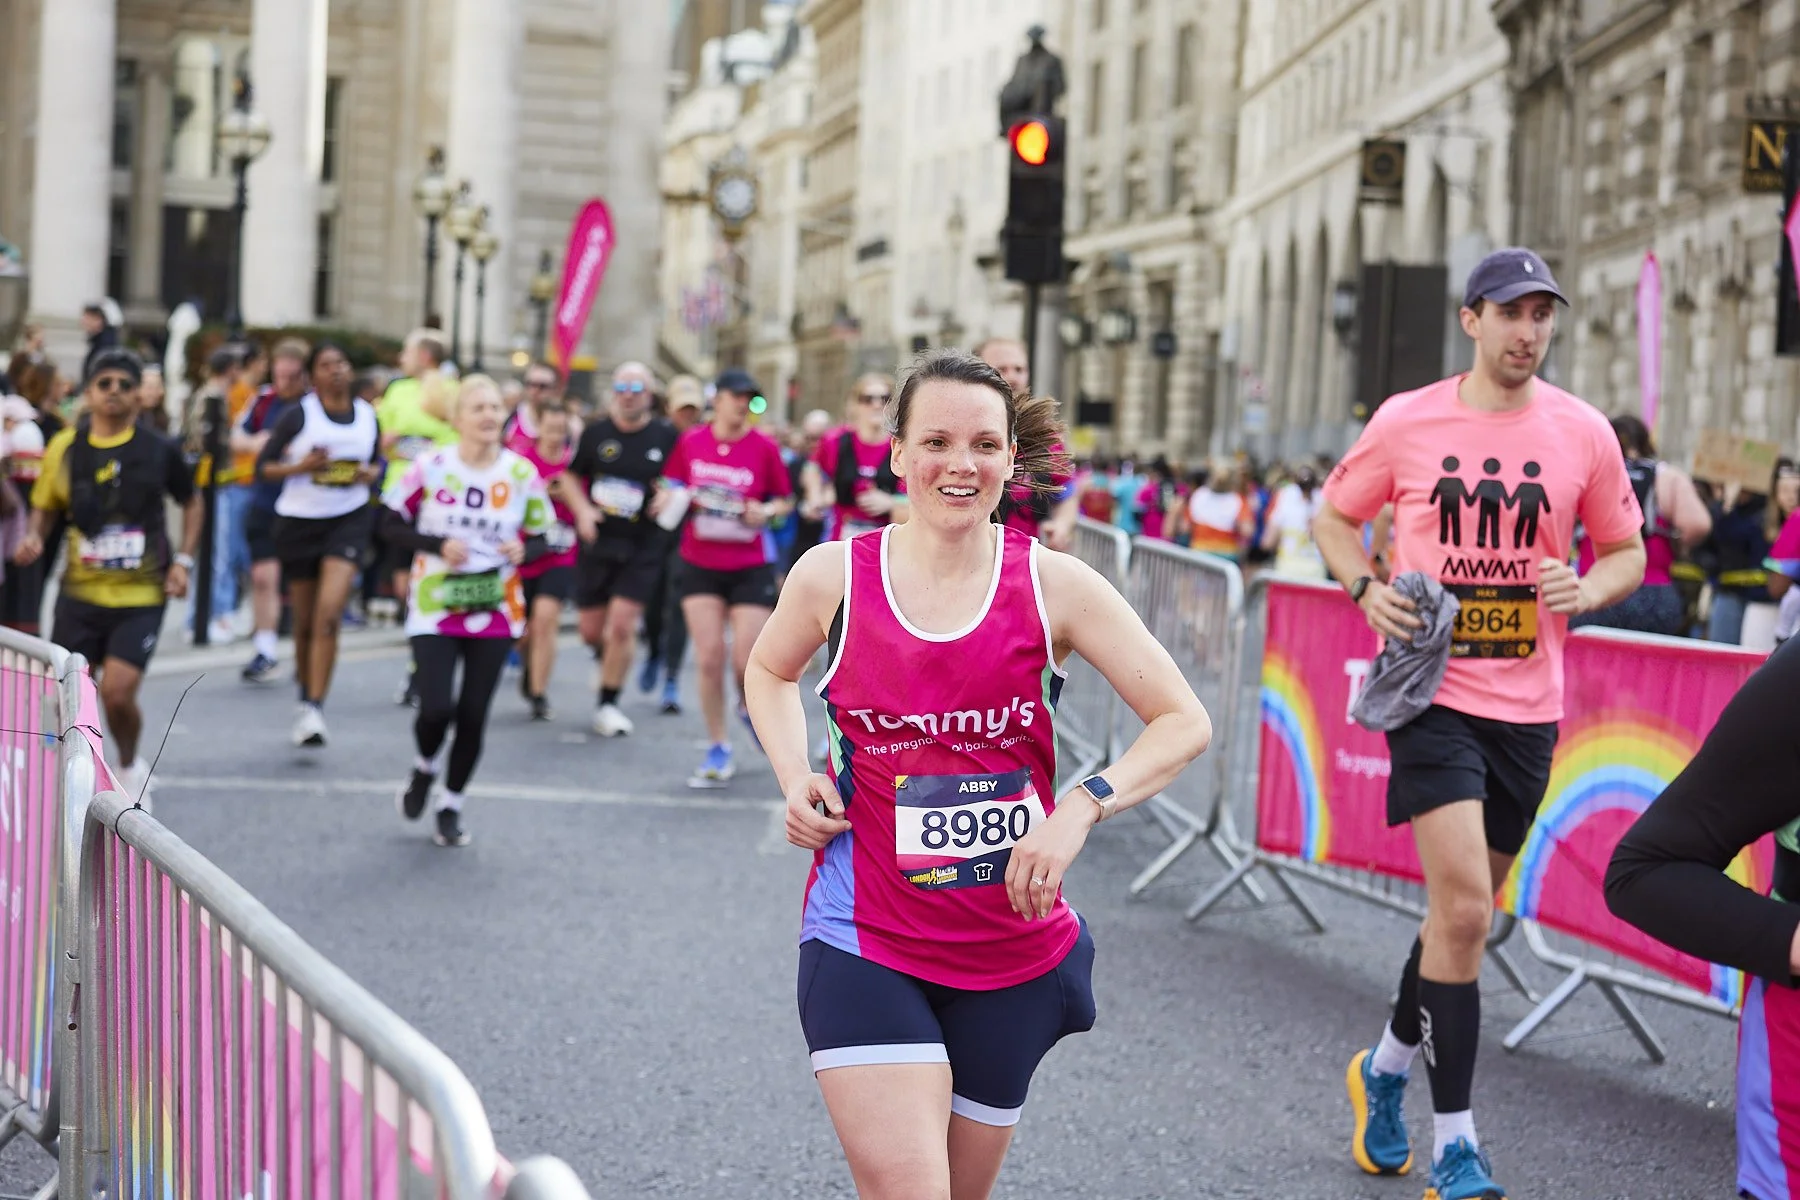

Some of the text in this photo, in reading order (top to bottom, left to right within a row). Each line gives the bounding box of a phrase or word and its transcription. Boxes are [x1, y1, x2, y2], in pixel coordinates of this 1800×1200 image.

[1442, 556, 1531, 579] MWMT
[848, 696, 1036, 739] Tommy's
[864, 745, 888, 756] The
[891, 737, 937, 754] pregna
[958, 780, 998, 794] ABBY
[920, 804, 1030, 850] 8980
